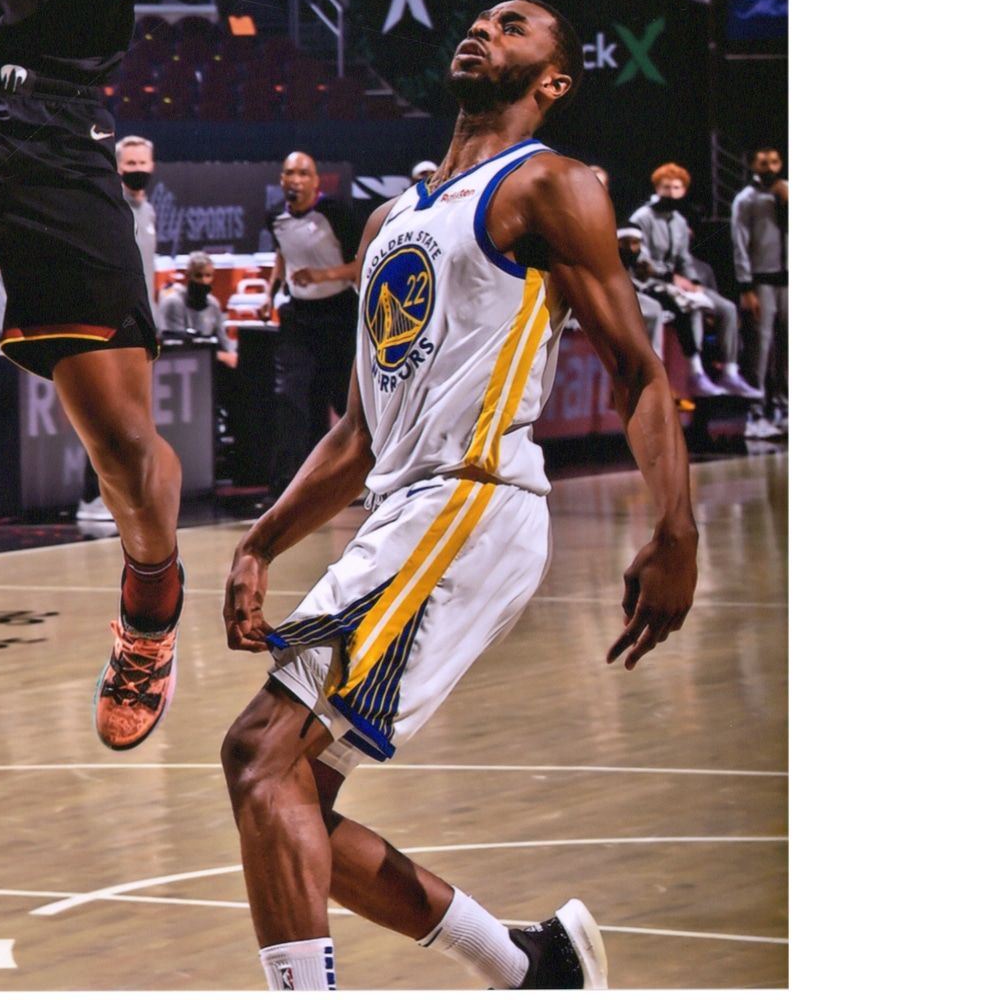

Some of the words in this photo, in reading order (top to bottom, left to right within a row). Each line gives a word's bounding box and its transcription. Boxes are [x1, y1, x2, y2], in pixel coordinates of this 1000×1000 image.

[186, 205, 244, 240] SPORTS
[416, 230, 442, 261] STATE
[403, 271, 430, 308] 22
